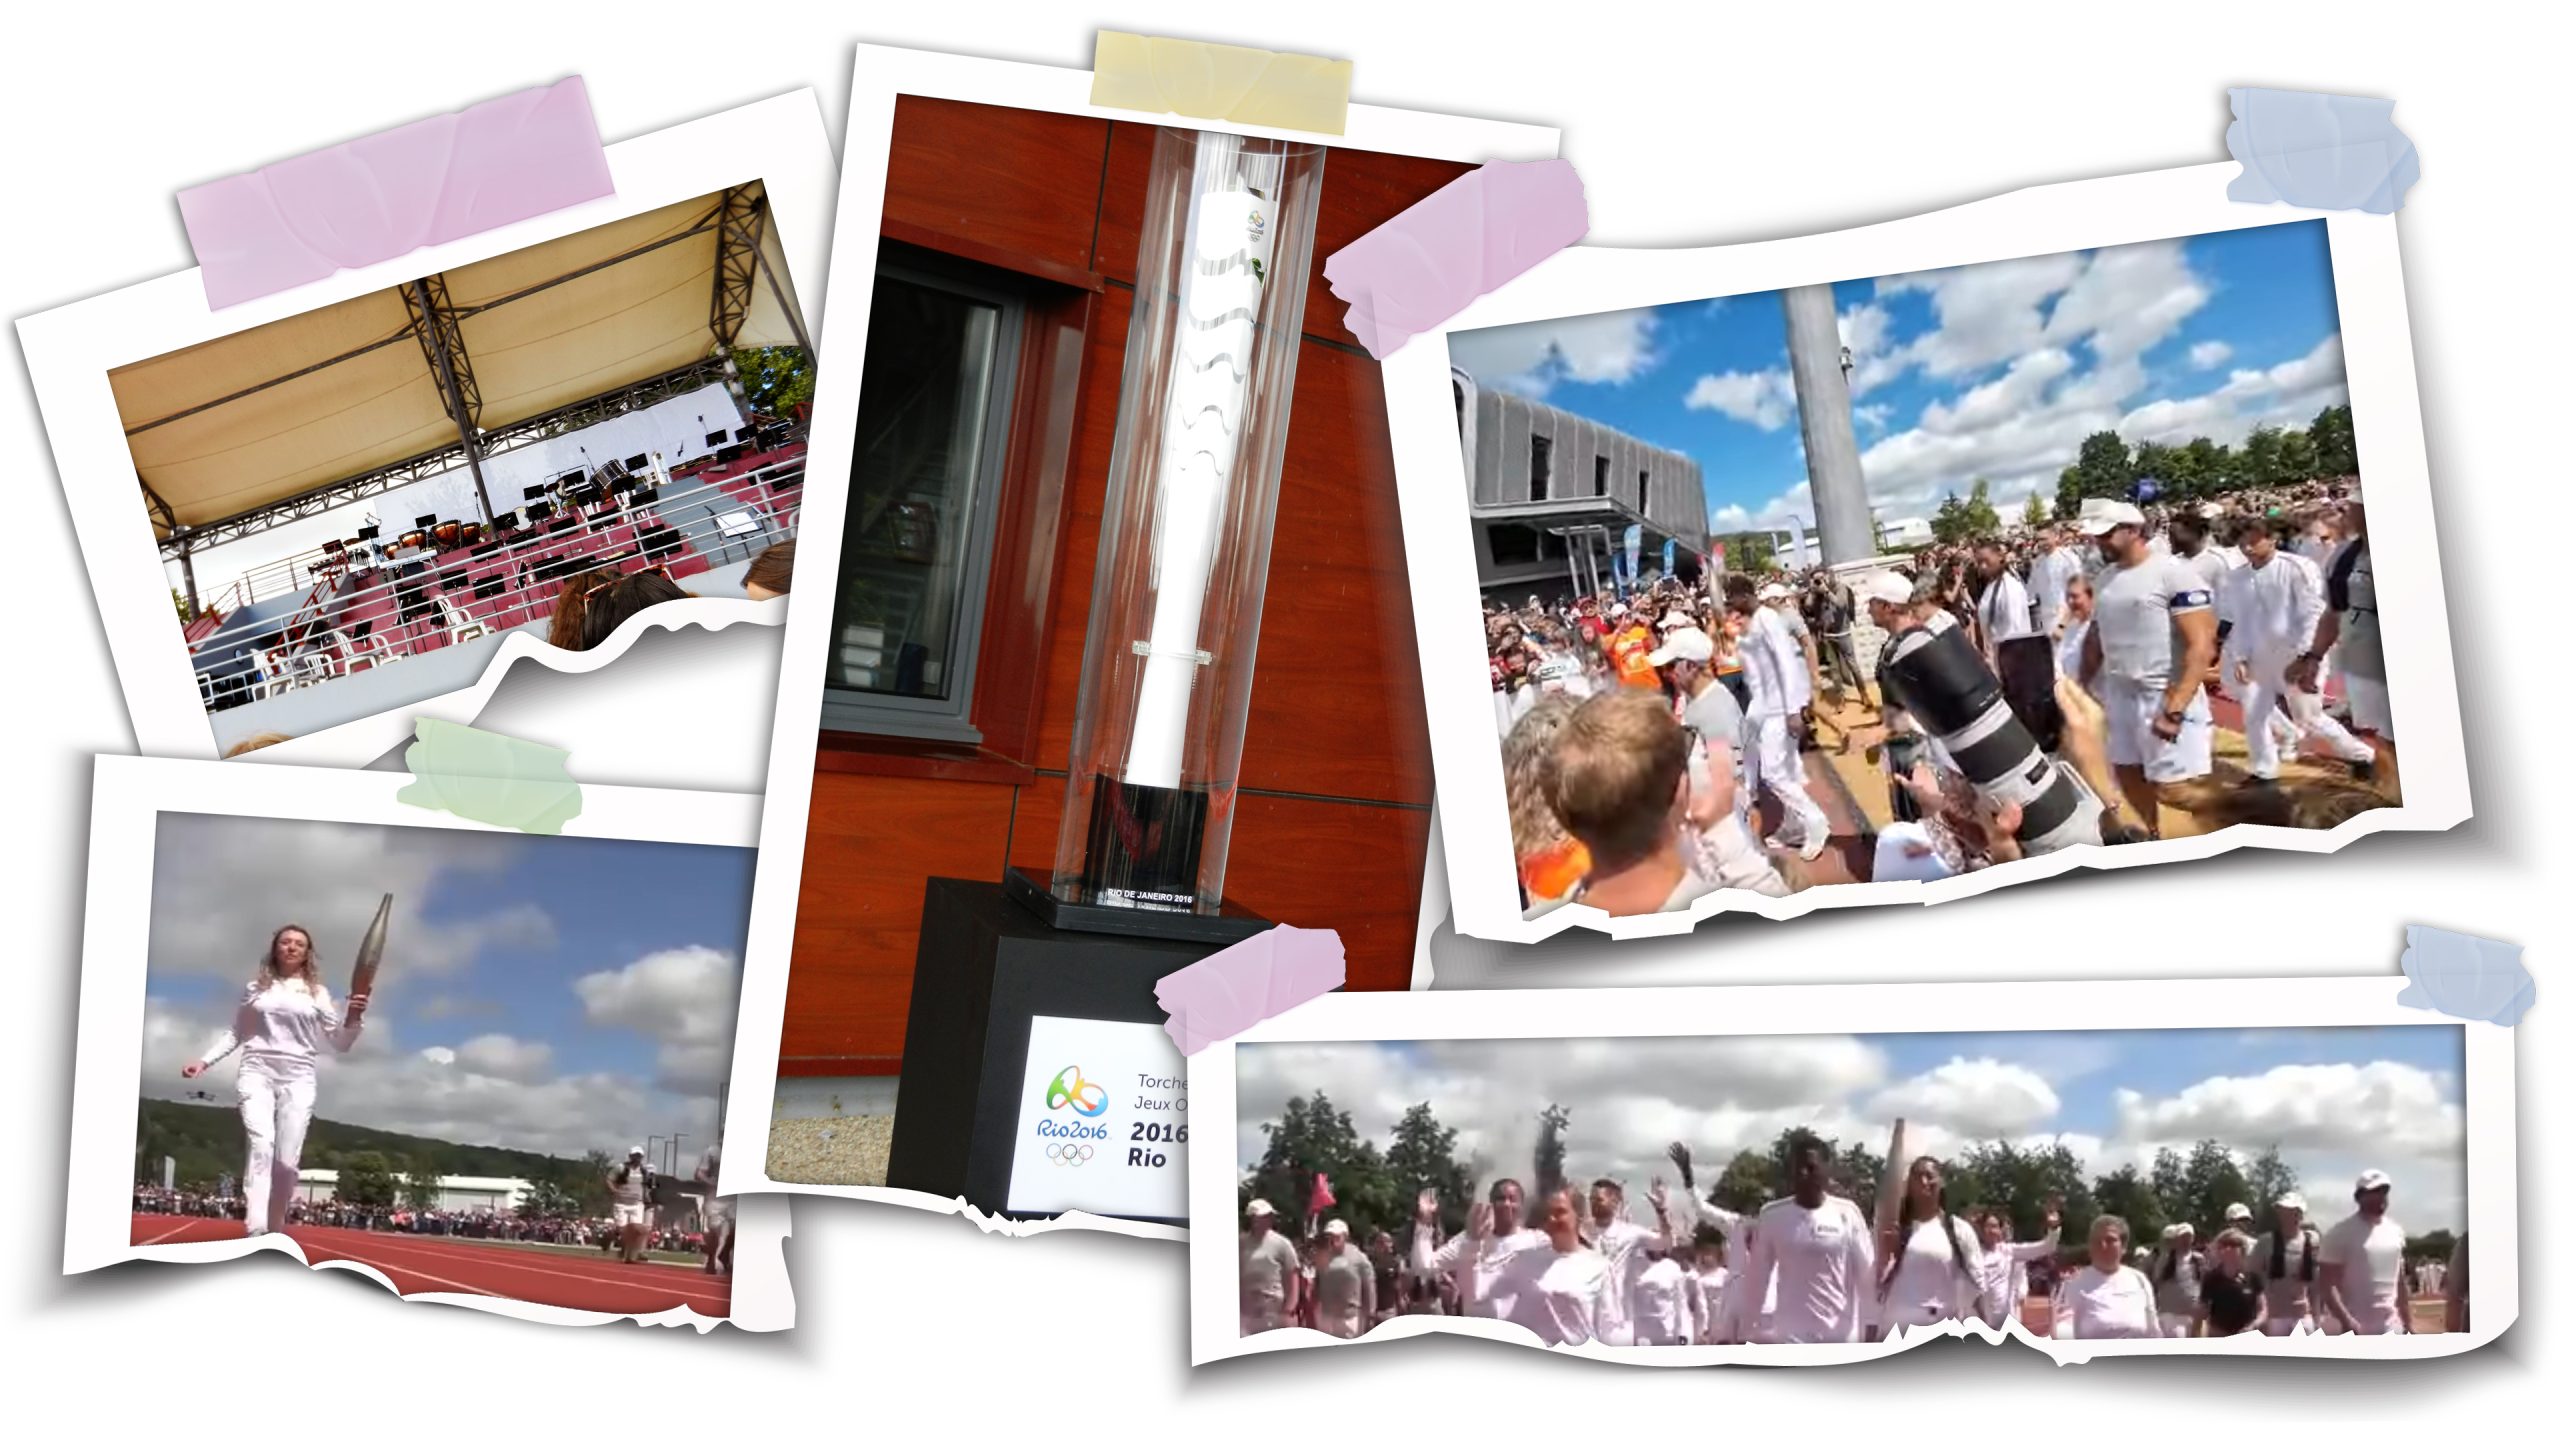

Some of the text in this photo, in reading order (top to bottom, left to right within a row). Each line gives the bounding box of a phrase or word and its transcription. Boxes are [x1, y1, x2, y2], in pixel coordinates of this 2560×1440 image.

[1107, 888, 1193, 903] RIO DE JANEIRO 2016
[1138, 1073, 1188, 1090] Torche
[1134, 1095, 1171, 1111] Jeux
[1037, 1118, 1108, 1140] Rio2016
[1130, 1121, 1188, 1144] 2016
[1127, 1146, 1167, 1168] Rio
